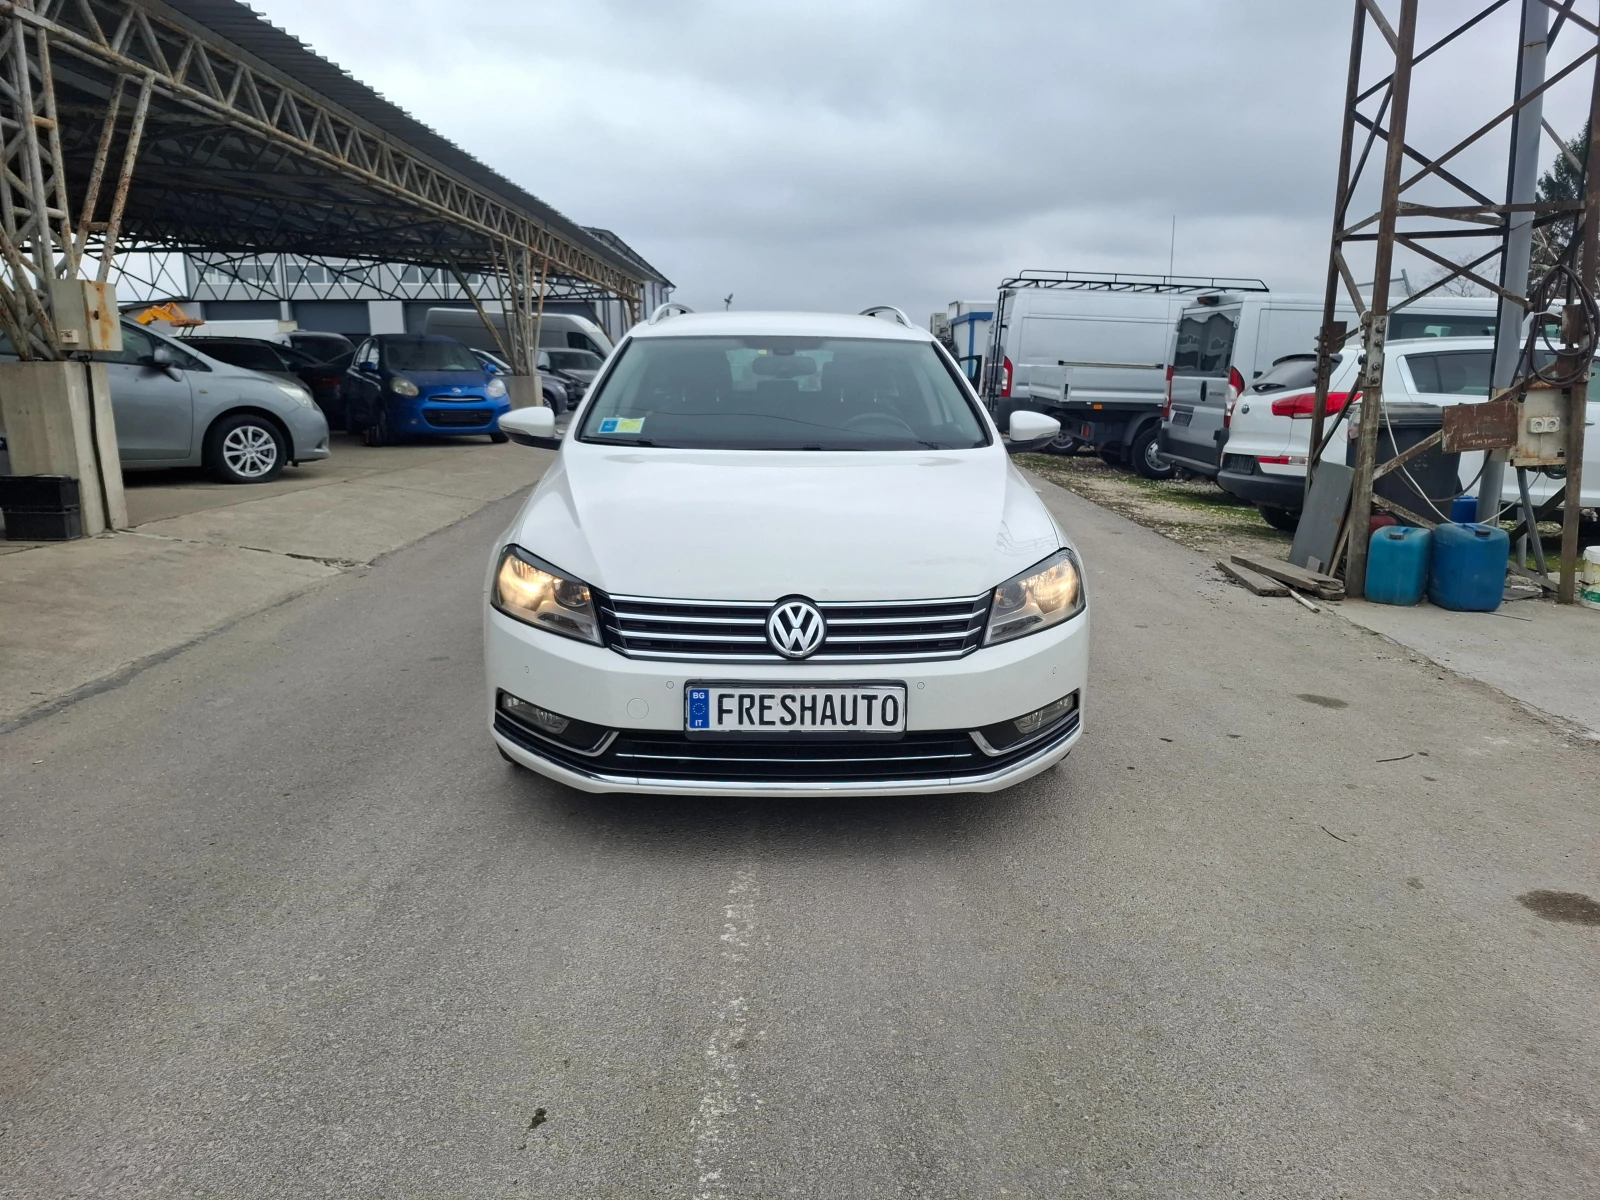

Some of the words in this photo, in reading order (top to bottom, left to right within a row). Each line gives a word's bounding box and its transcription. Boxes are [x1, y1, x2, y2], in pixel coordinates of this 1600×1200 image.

[769, 602, 824, 657] VW
[695, 719, 703, 727] IT
[717, 693, 899, 727] FRESHAUTO
